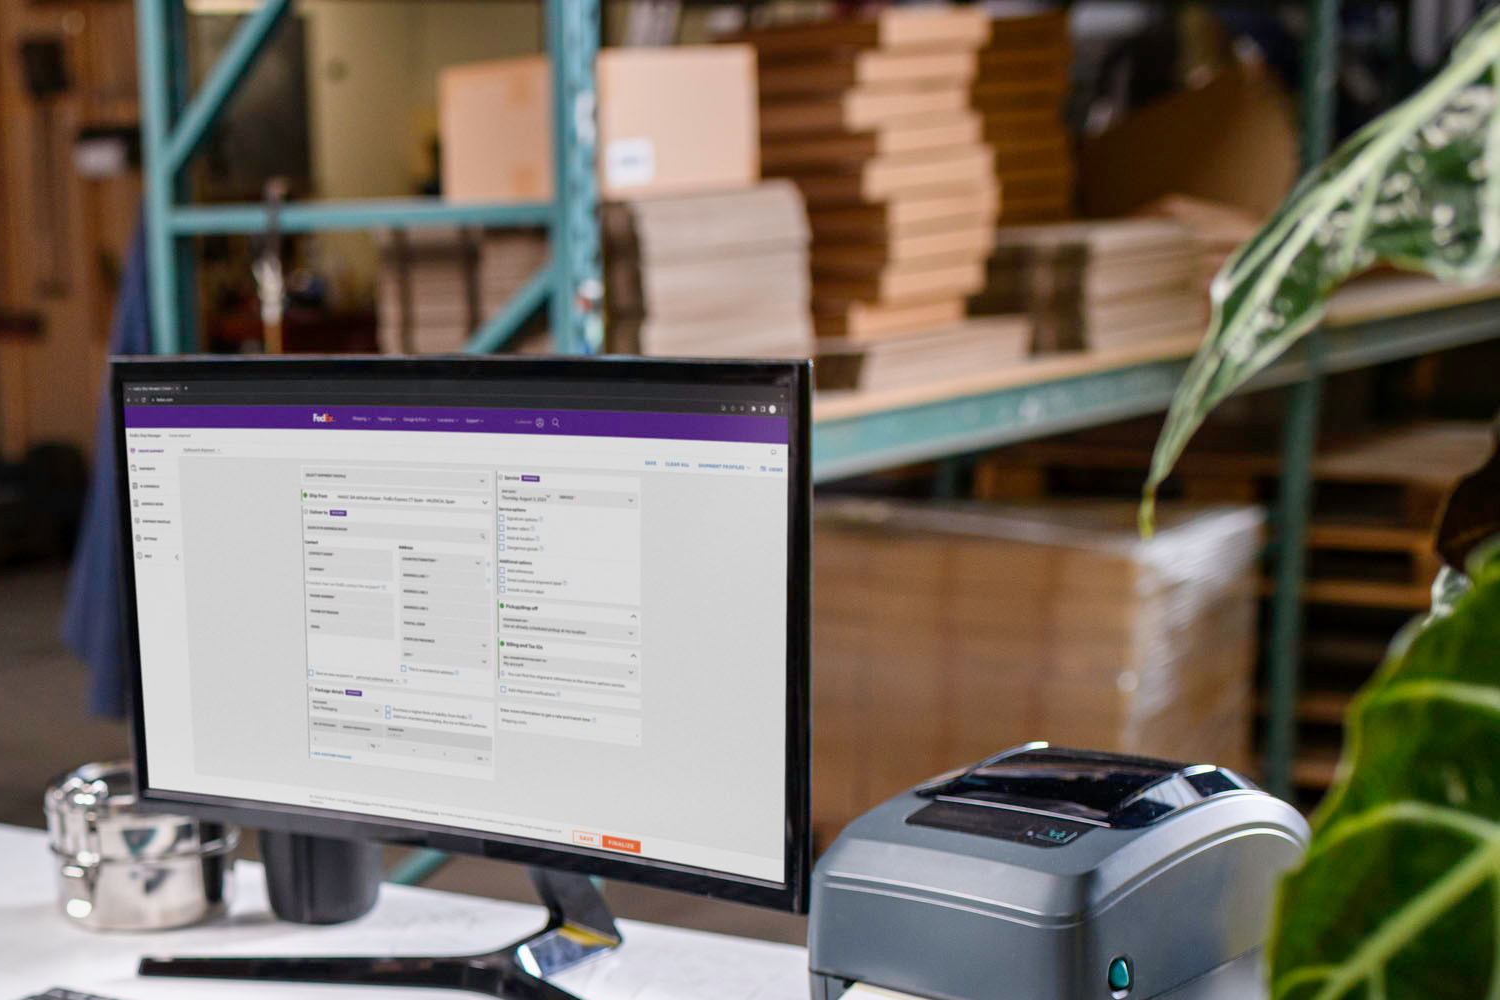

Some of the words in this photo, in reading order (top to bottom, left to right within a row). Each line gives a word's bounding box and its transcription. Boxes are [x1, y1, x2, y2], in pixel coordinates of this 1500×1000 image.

[312, 412, 334, 423] FedEx
[578, 833, 595, 843] SAVE
[608, 839, 635, 850] FINALIZE
